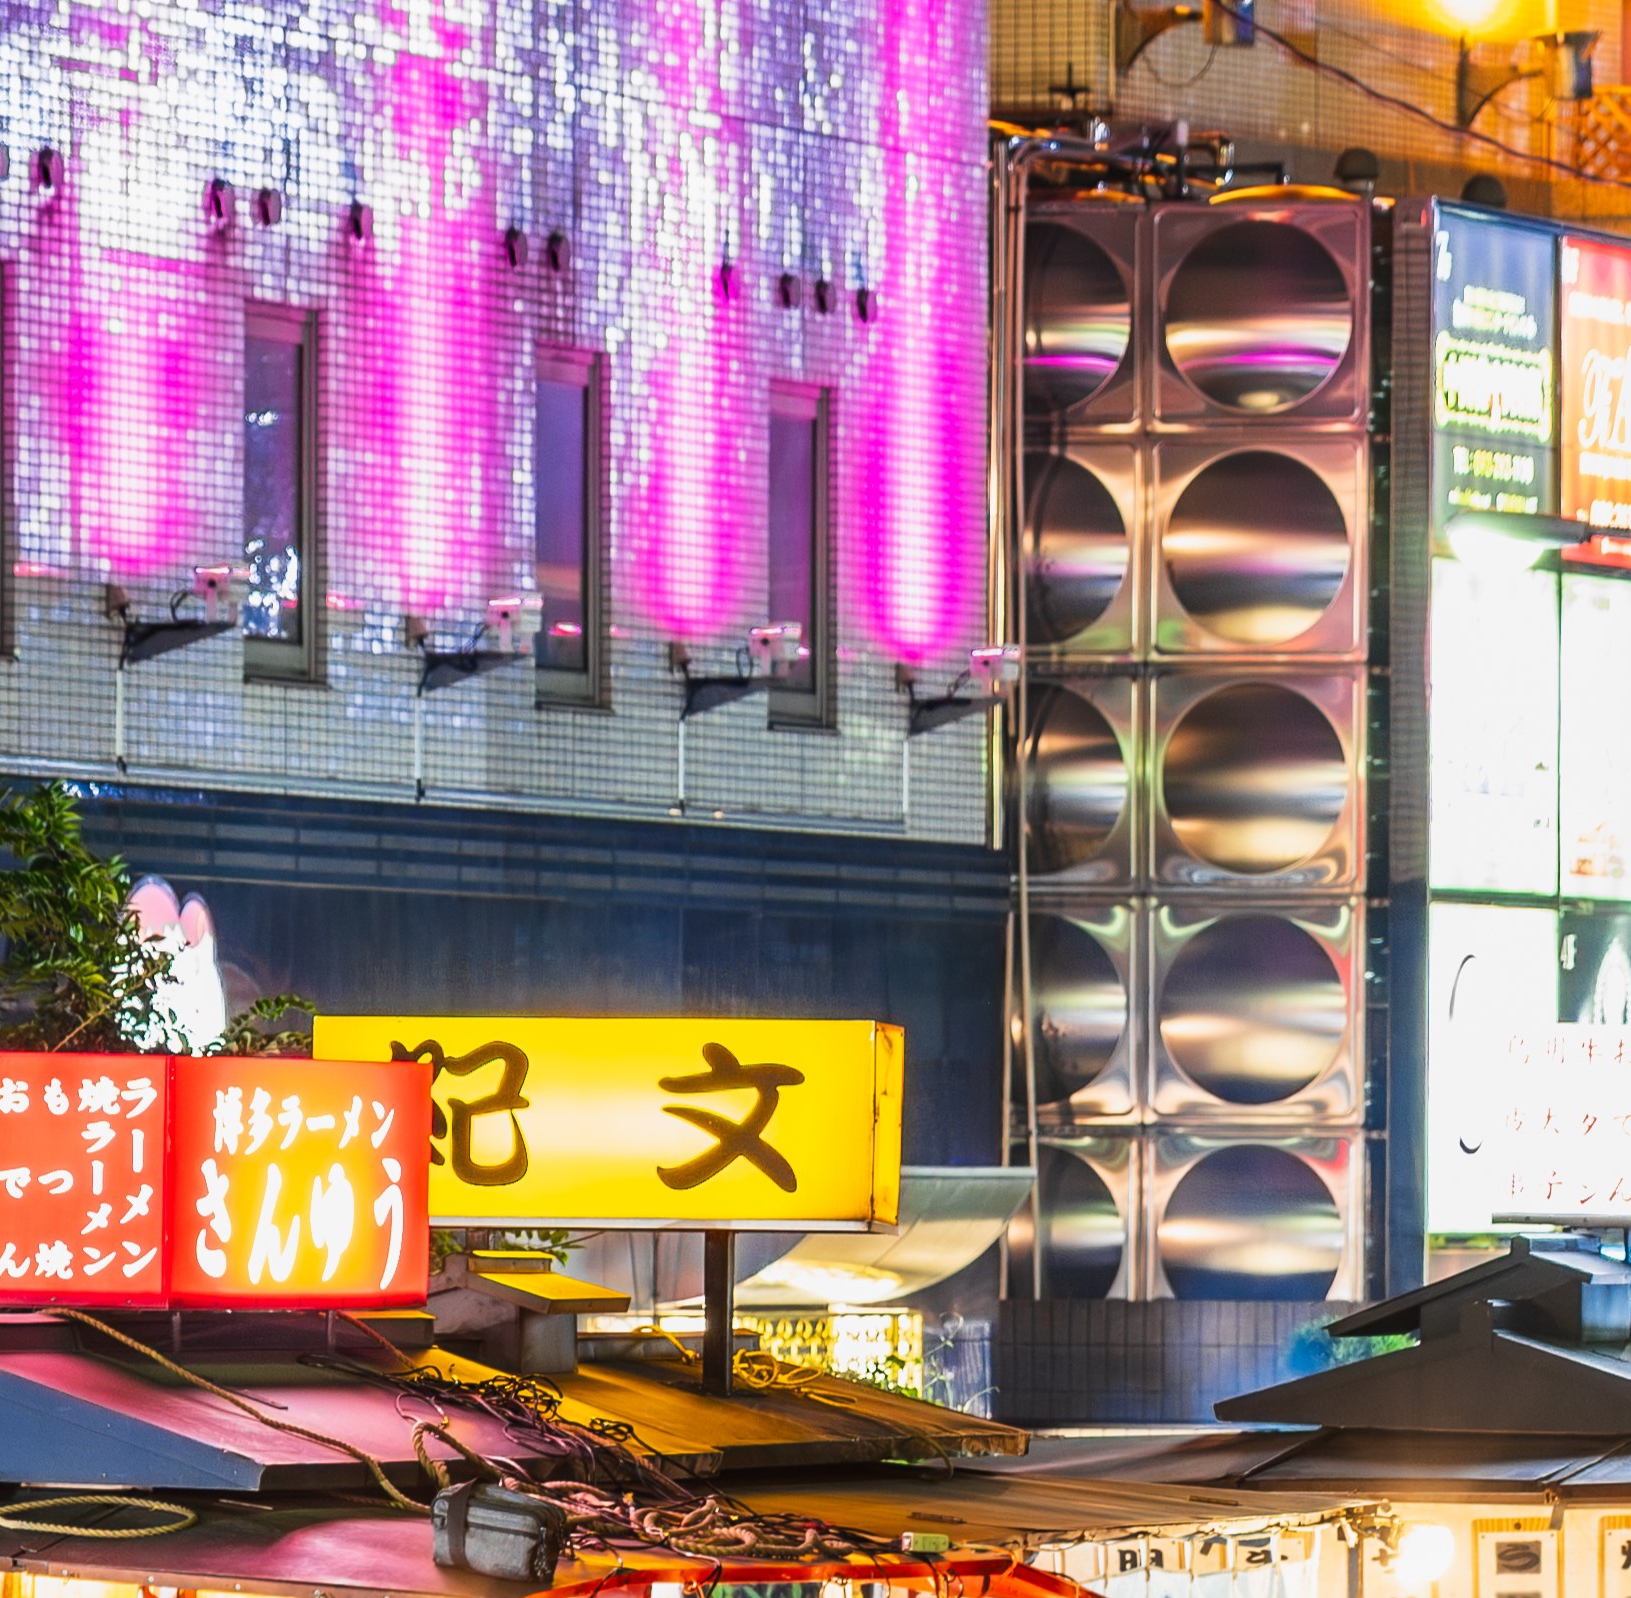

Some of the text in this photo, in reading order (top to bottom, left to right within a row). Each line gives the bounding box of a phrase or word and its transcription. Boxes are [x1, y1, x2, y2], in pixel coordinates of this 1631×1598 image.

[34, 1078, 74, 1280] もつ焼
[77, 1076, 121, 1276] 焼ラーメン
[120, 1077, 158, 1278] ラーメン
[213, 1086, 395, 1155] 博多ラーメン
[196, 1157, 404, 1290] さんゆう
